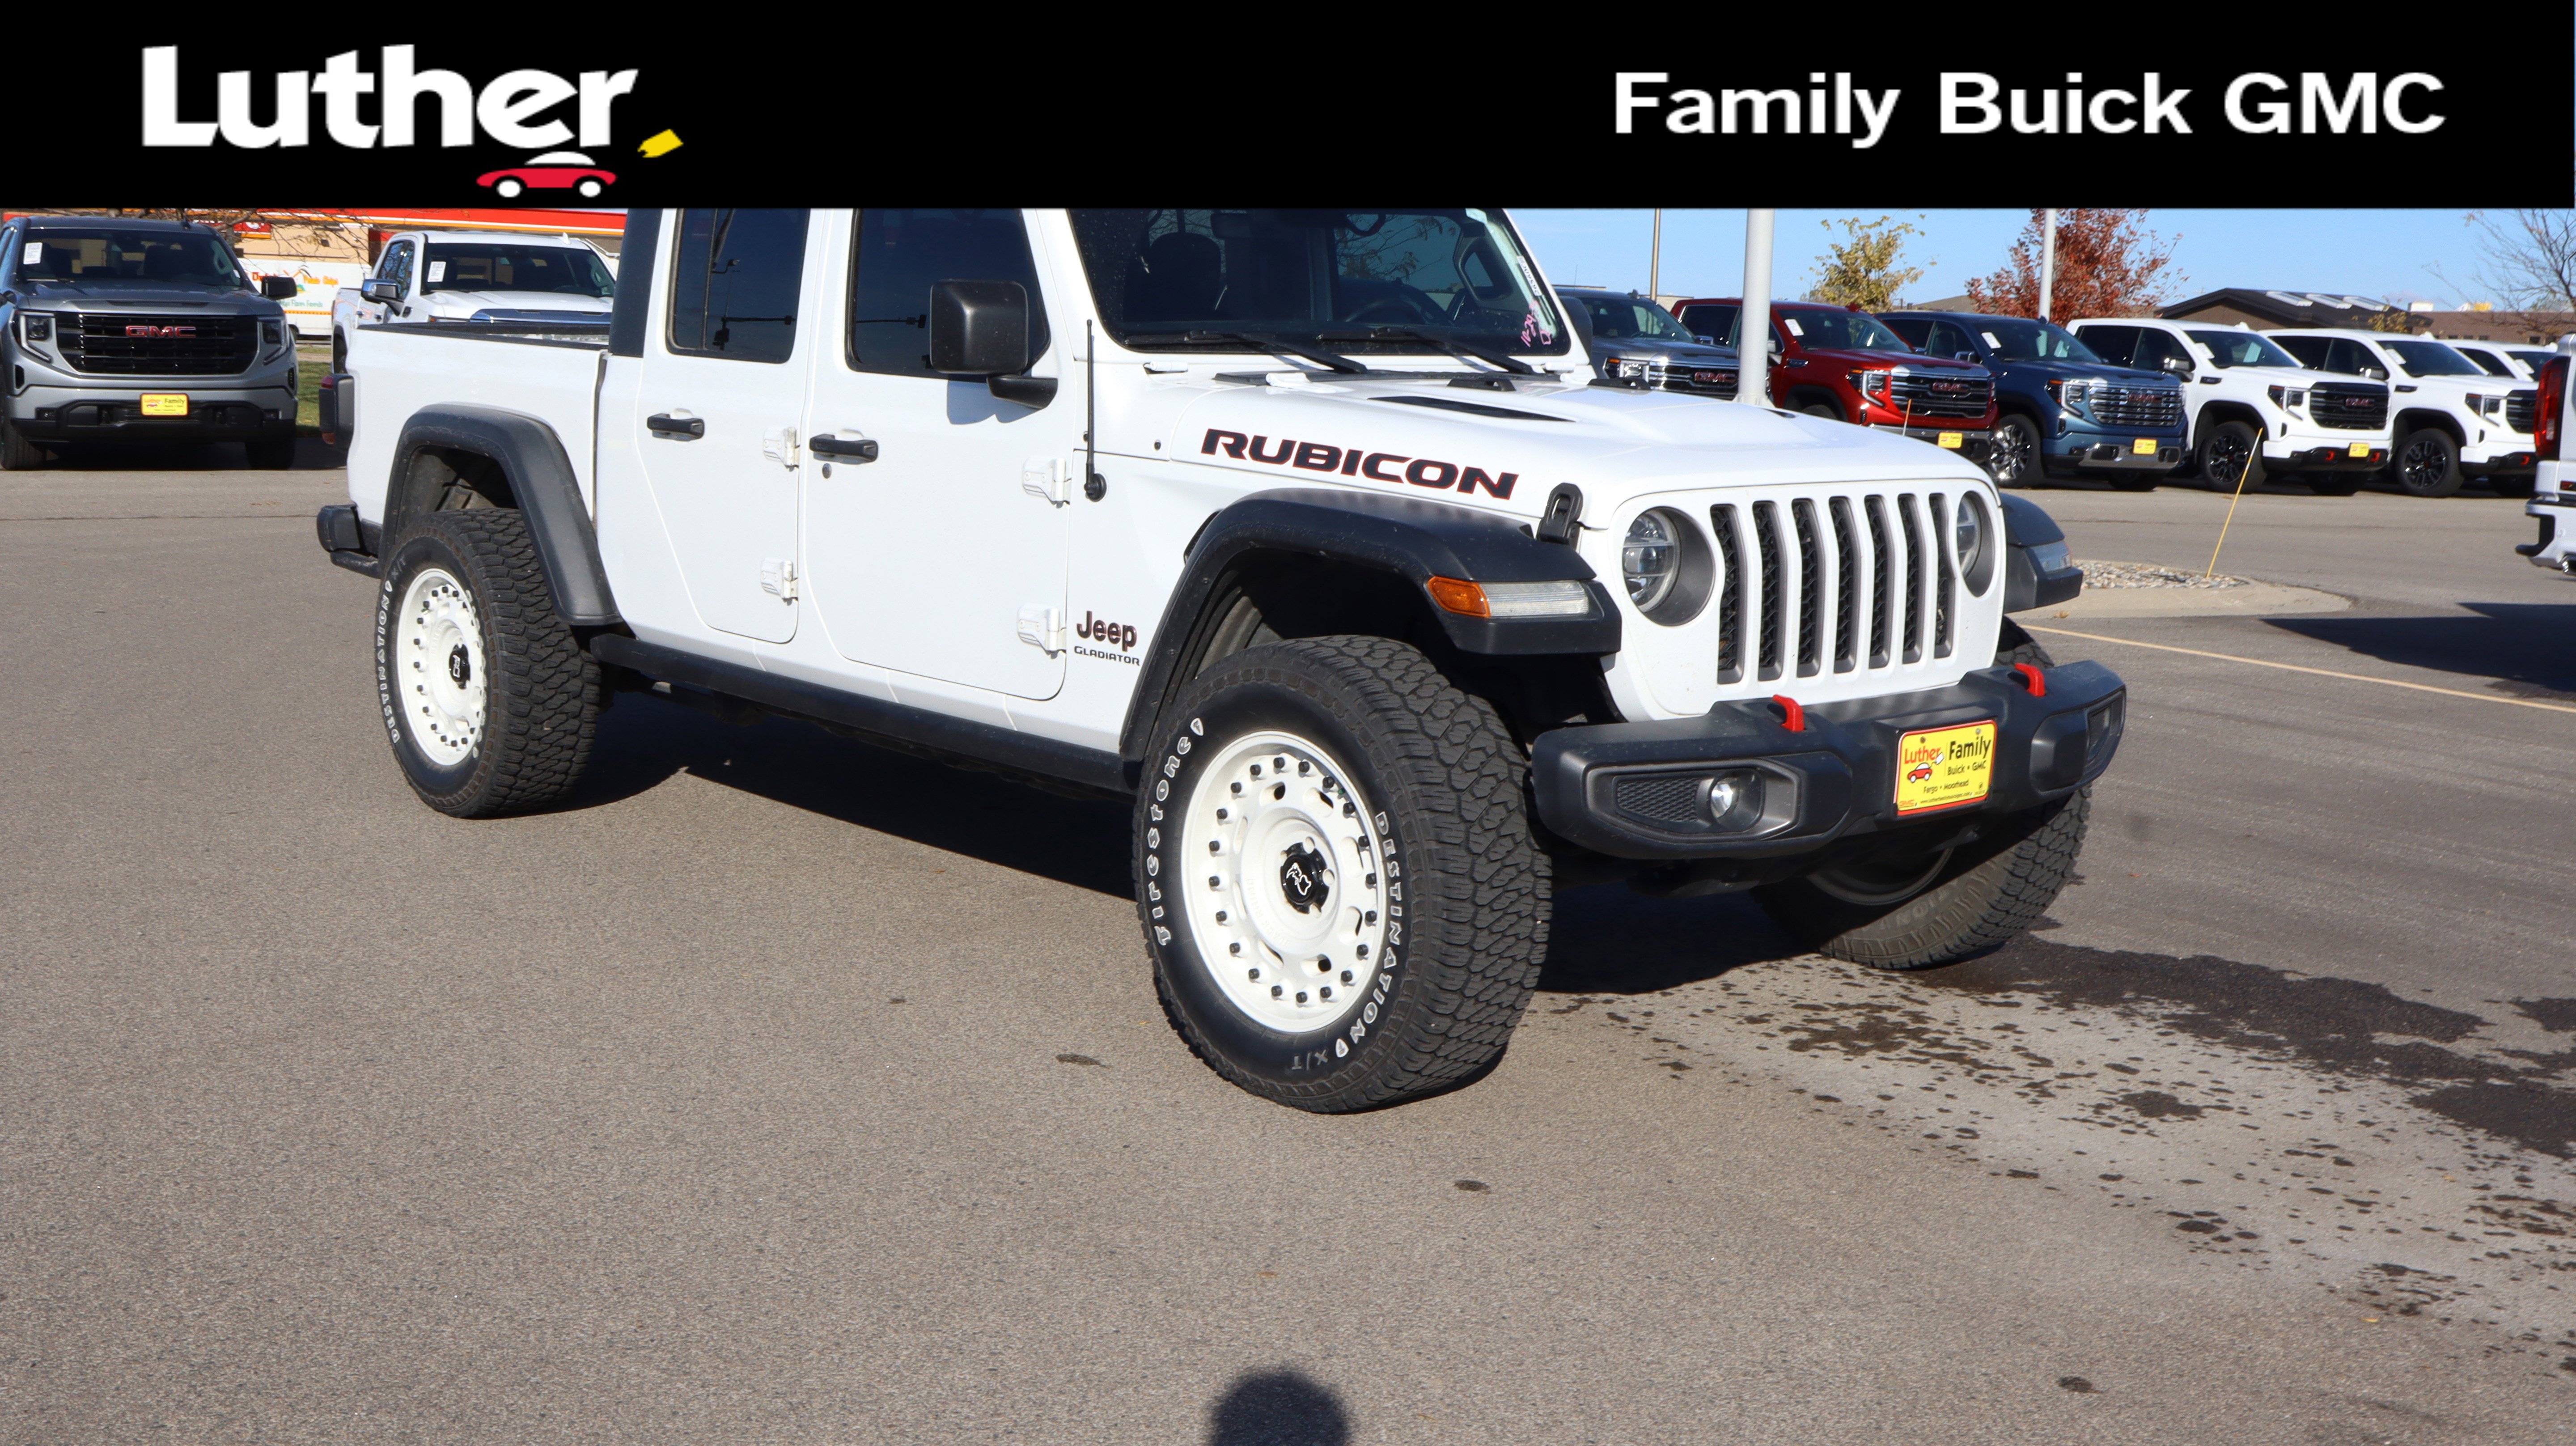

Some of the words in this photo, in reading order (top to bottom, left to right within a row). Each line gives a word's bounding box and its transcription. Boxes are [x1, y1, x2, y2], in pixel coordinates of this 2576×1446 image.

[126, 325, 196, 338] GMC
[1695, 372, 1735, 383] GMC
[1200, 428, 1520, 500] RUBICON
[1076, 610, 1137, 652] Jeep
[1074, 645, 1140, 666] GLADIATOR
[377, 594, 400, 743] DESTINATION
[1904, 746, 1942, 764] Luther
[1949, 735, 1991, 761] Family
[1947, 764, 1965, 776] Buick
[1972, 760, 1987, 771] GMC
[1924, 786, 1938, 794] Fargo
[1944, 780, 1969, 790] Moorhead
[1350, 811, 1402, 1043] DESTINATION
[1292, 1049, 1328, 1070] X/T
